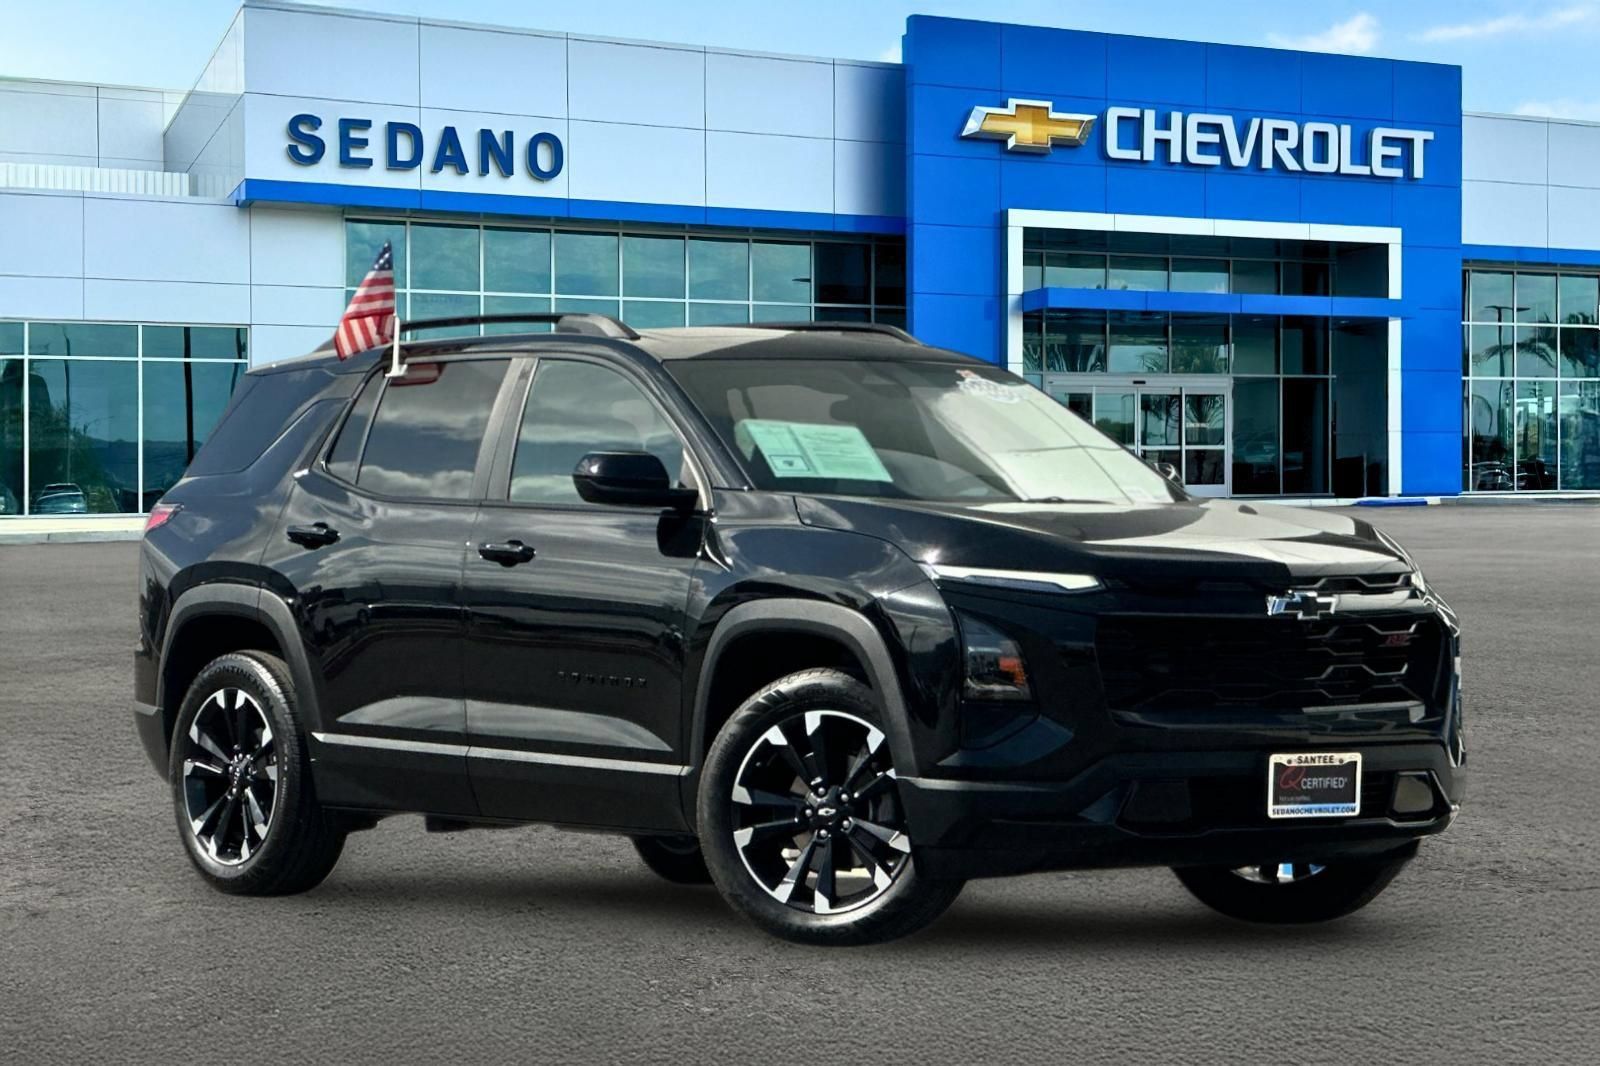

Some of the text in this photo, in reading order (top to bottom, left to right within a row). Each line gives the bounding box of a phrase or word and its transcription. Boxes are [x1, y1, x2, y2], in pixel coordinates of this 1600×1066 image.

[287, 113, 564, 182] SEDANO
[1105, 106, 1435, 179] CHEVROLET
[1297, 755, 1335, 764] SANTEE
[1272, 805, 1357, 815] SEDANOCHEVROLET.COM
